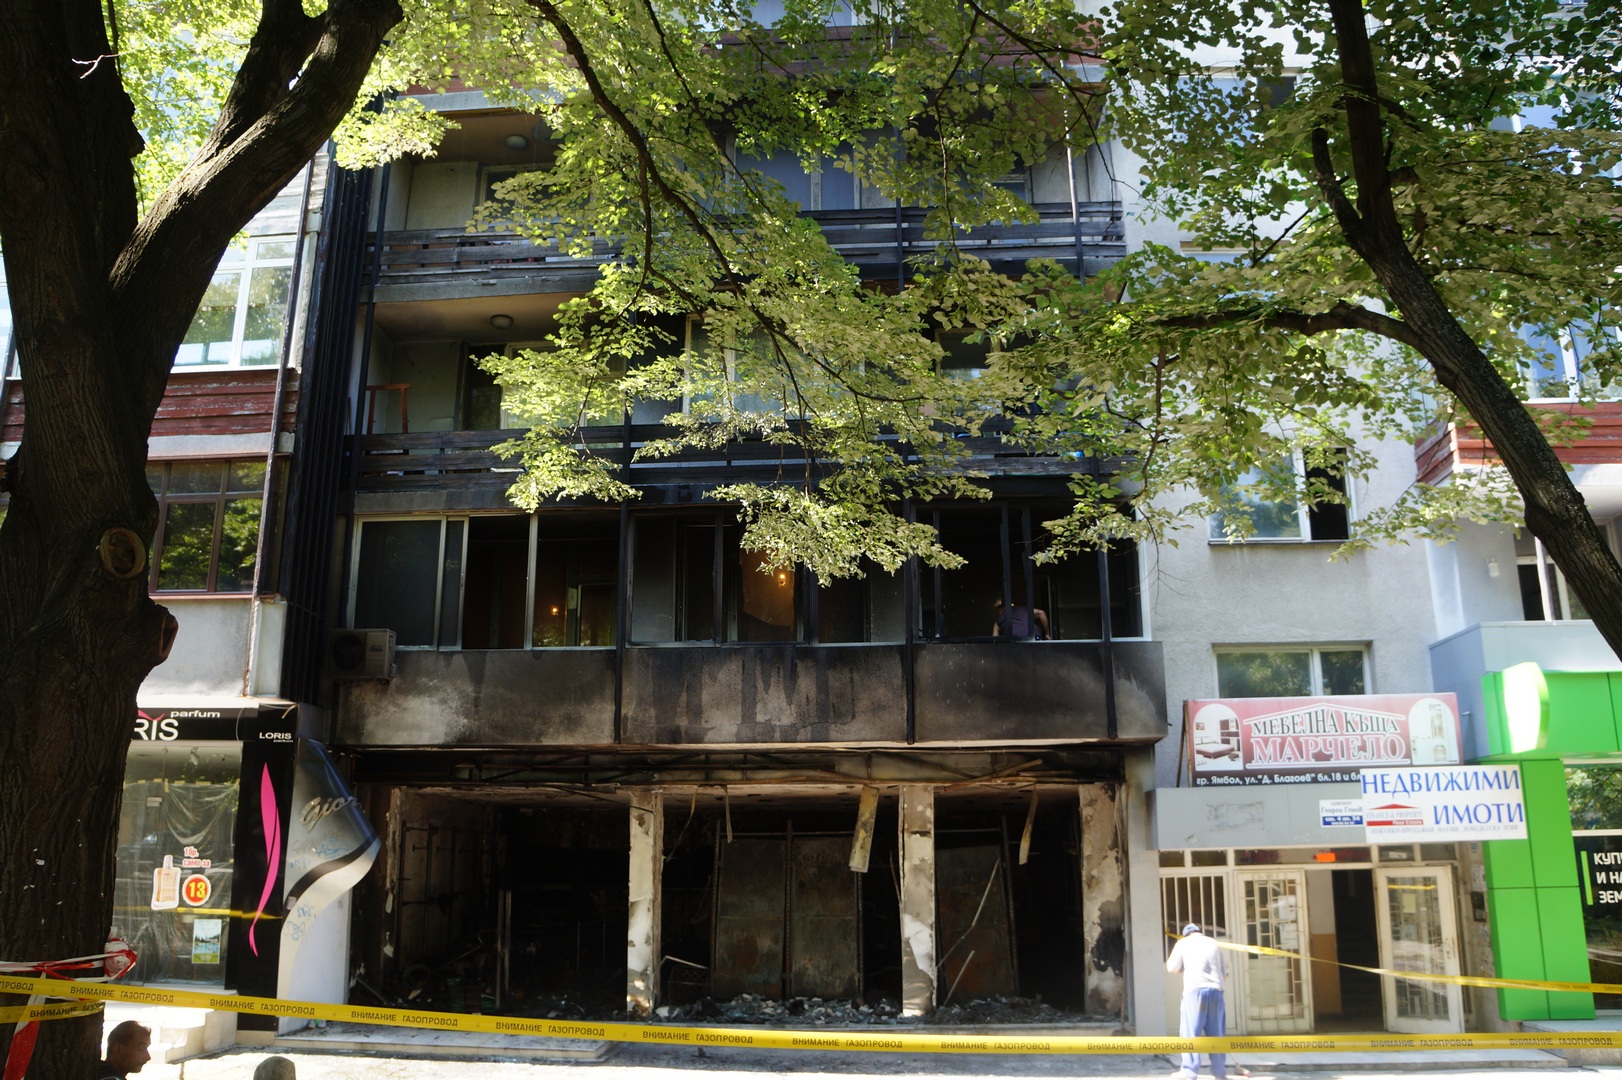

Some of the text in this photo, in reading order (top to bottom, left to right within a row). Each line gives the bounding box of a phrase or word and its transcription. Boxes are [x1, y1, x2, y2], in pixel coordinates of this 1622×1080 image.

[170, 710, 221, 718] parfum
[1252, 709, 1399, 737] МЕБЕЛНА КЪЩА
[259, 731, 292, 740] LORIS
[1251, 735, 1406, 764] МАРЧЕЛО
[1196, 777, 1209, 786] гр.
[1211, 775, 1242, 785] Ямбол,
[1361, 769, 1525, 825] НЕДВИЖИМИ ИМОТИ
[1594, 852, 1622, 865] КУП
[1596, 871, 1607, 884] И
[189, 881, 207, 899] 13
[70, 986, 174, 1004] ВНИМАНИЕ ГАЗОПРОВОД
[210, 998, 315, 1016] ВНИМАНИЕ ГАЗОПРОВОД
[351, 1011, 458, 1027] ВНИМАНИЕ ГАЗОПРОВОД
[495, 1022, 605, 1037] ВНИМАНИЕ ГАЗОПРОВОД
[642, 1031, 753, 1044] ВНИМАНИЕ ГАЗОПРОВОД
[792, 1037, 903, 1049] ВНИМАНИЕ ГАЗОПРОВОД
[1371, 1038, 1474, 1048] ВНИМАНИЕ ГАЗОПРОВОД
[1509, 1037, 1613, 1046] ВНИМАНИЕ ГАЗОПРОВОД
[941, 1041, 1051, 1051] ВНИМАНИЕ ГАЗОПРОВОД
[1087, 1042, 1195, 1051] ВНИМАНИЕ ГАЗОПРОВОД
[1230, 1041, 1336, 1050] ВНИМАНИЕ ГАЗОПРОВОД
